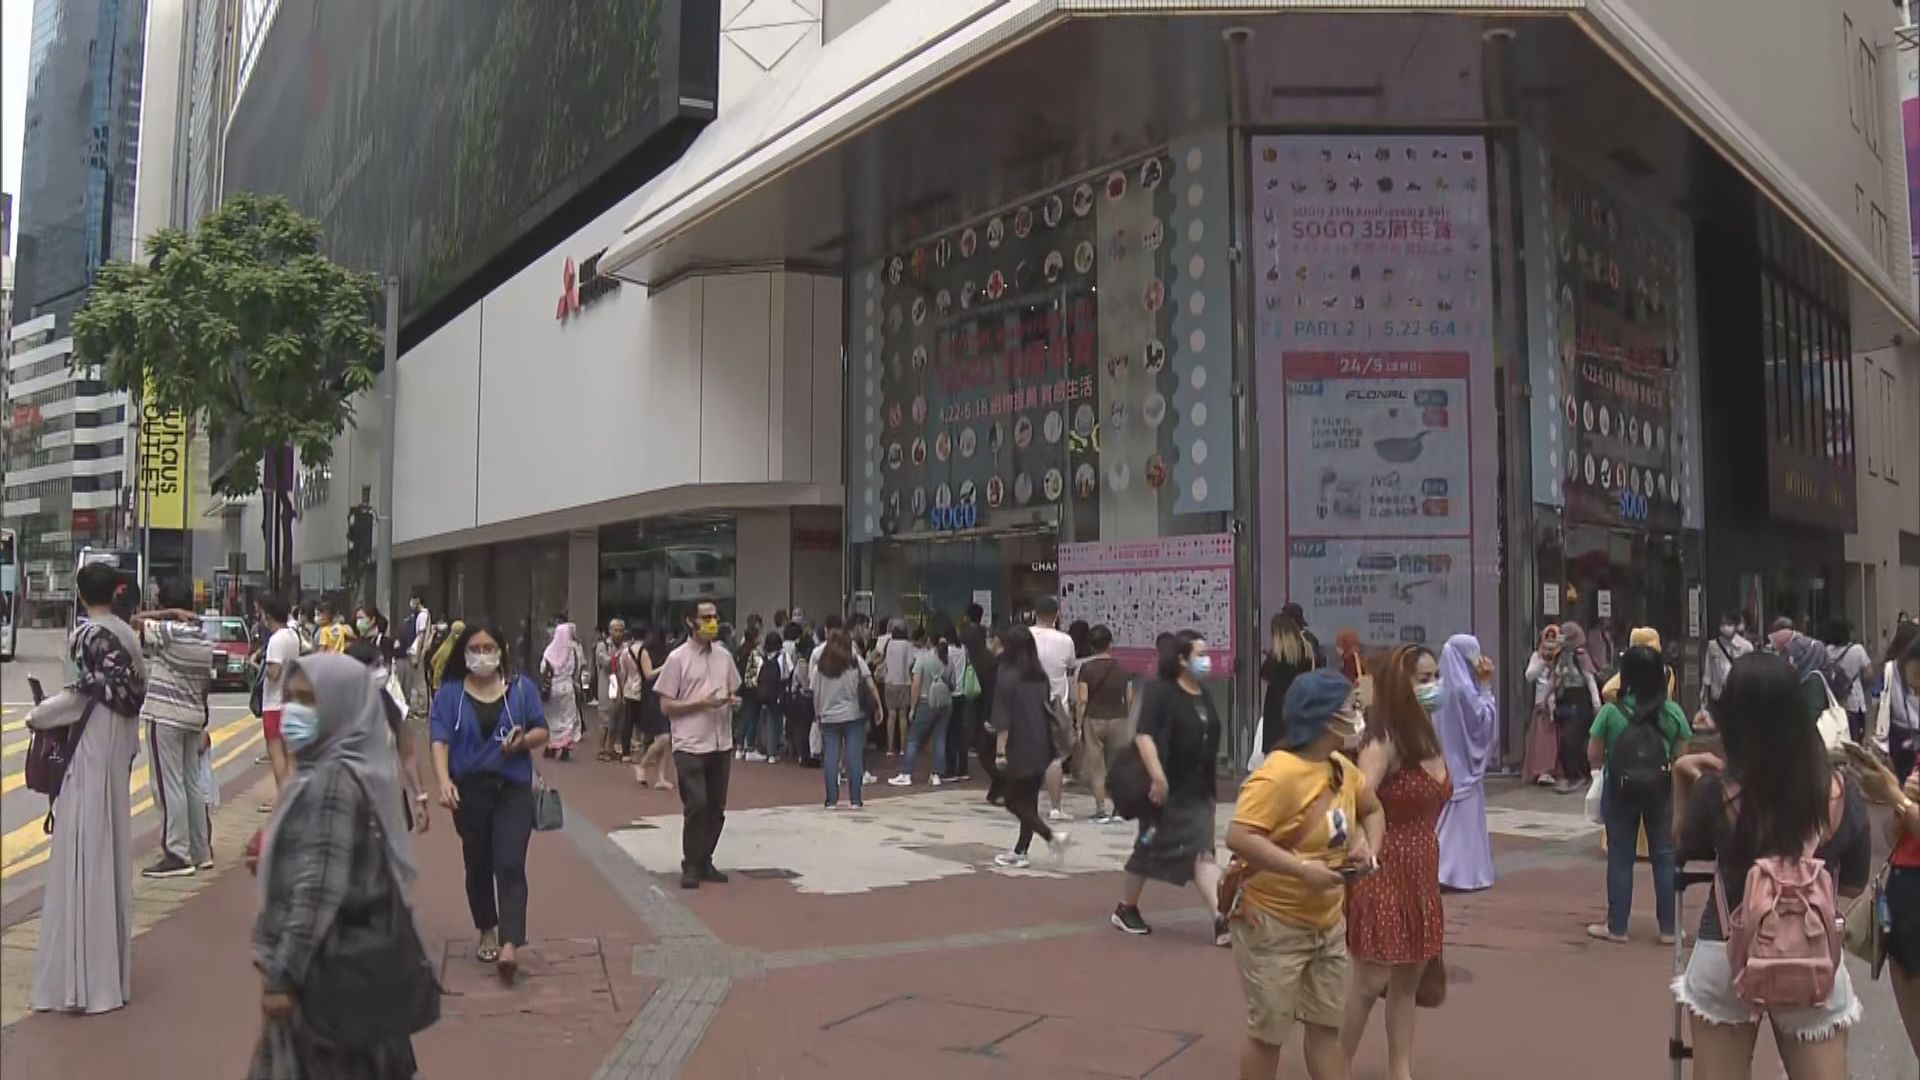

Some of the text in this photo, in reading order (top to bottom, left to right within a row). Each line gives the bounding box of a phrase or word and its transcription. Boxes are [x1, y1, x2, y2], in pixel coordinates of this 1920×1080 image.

[1292, 220, 1355, 240] SOGO
[1294, 320, 1338, 336] PART
[140, 404, 161, 497] OUTLET
[160, 407, 184, 494] uhaus
[931, 503, 977, 530] SOGO
